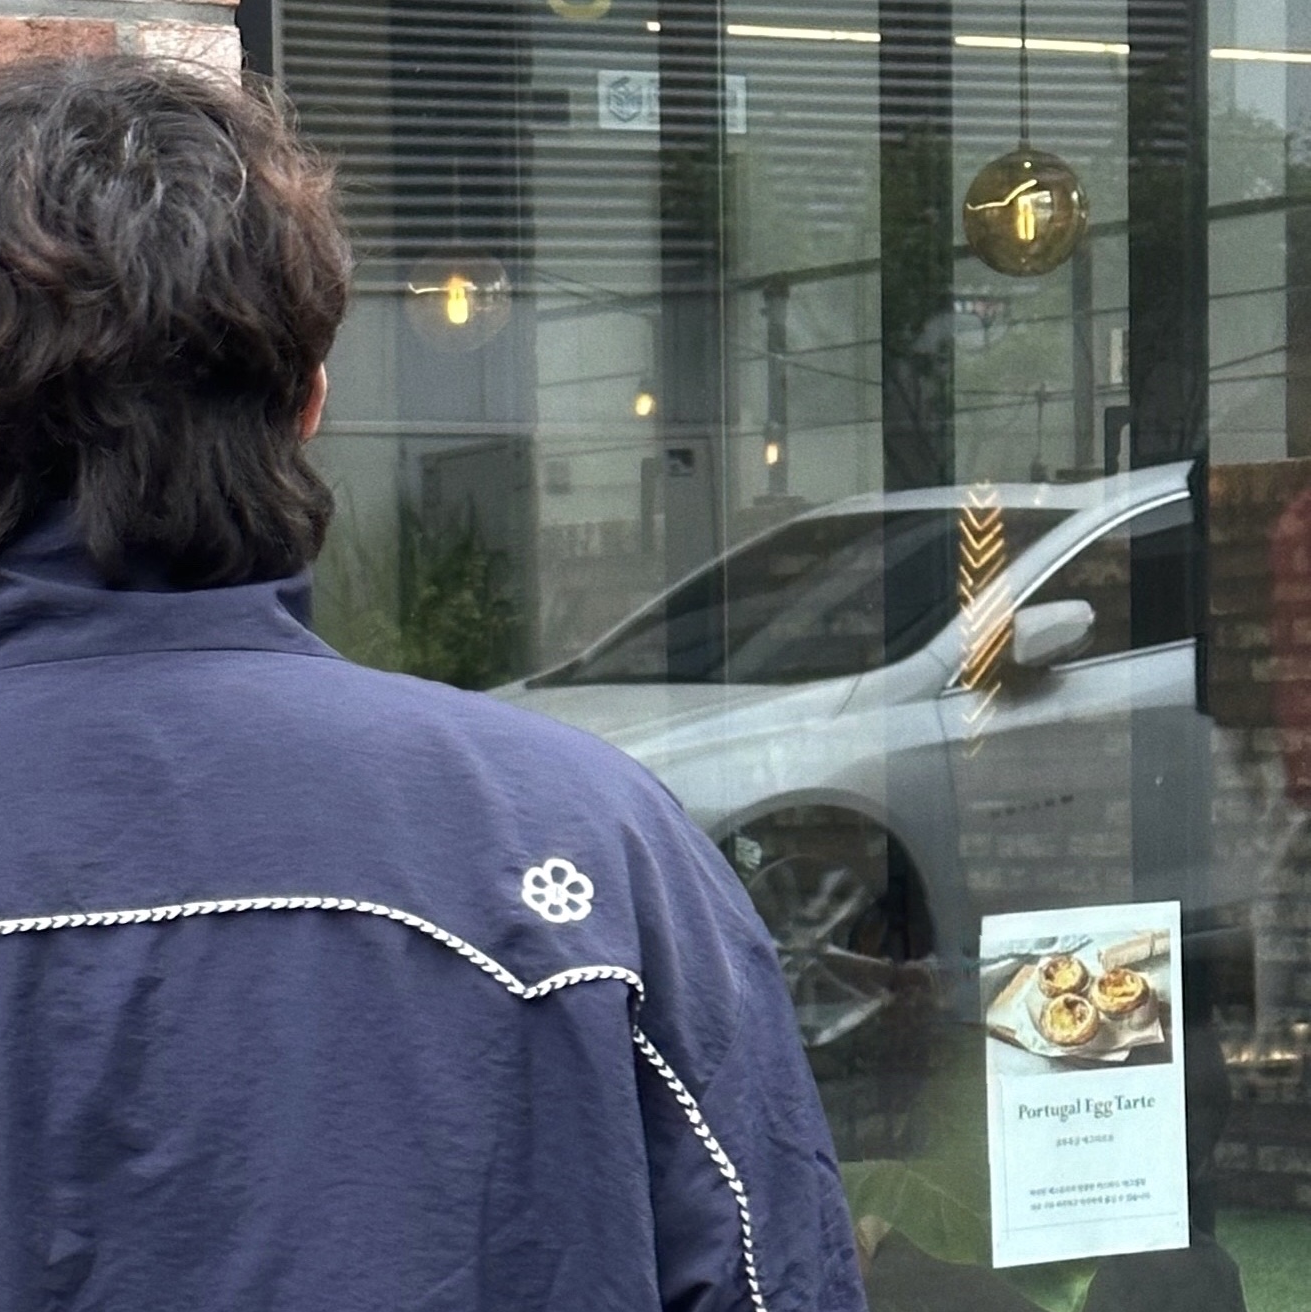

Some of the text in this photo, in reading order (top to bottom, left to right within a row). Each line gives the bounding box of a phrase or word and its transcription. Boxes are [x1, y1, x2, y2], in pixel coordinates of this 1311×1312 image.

[1018, 1095, 1156, 1122] Portugal Egg Tarte
